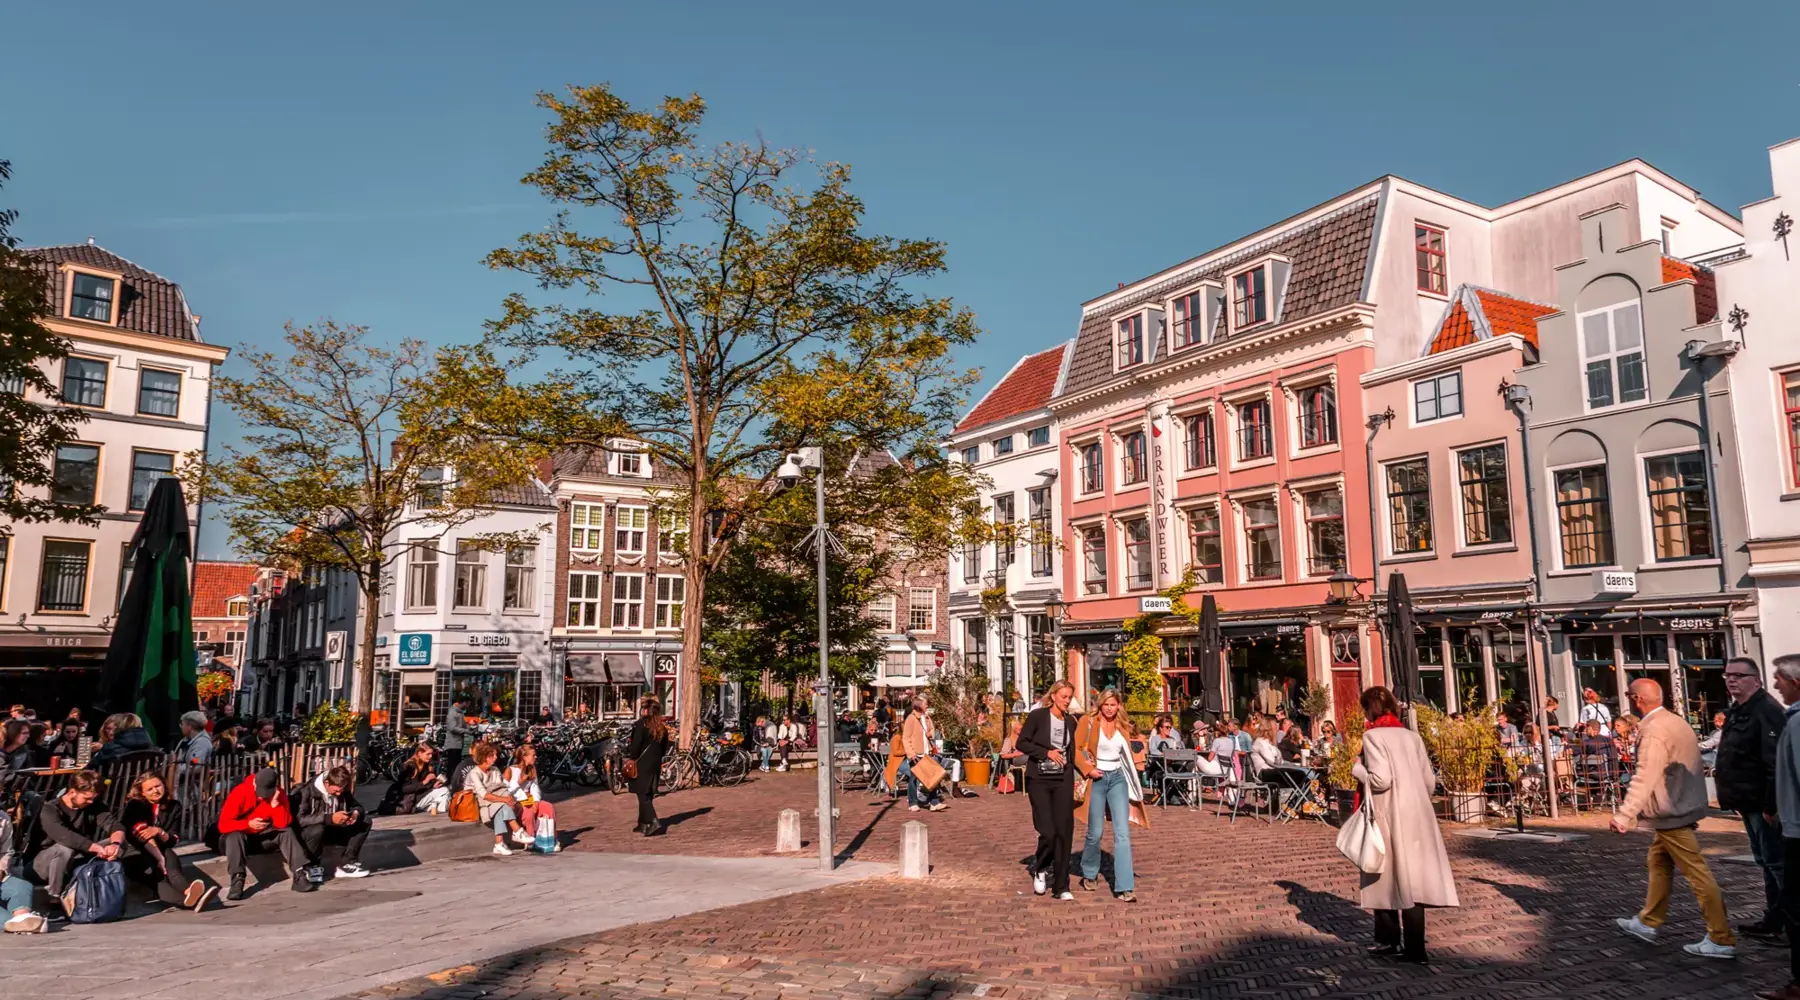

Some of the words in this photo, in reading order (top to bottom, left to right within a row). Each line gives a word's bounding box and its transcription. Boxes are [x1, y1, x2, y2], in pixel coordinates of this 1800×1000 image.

[1154, 445, 1169, 575] BRANDWEER
[1606, 574, 1634, 586] daen's
[1144, 600, 1171, 608] daen's
[46, 638, 82, 646] UBICA
[468, 634, 480, 646] EL
[482, 635, 510, 647] GRECO
[402, 650, 408, 658] EL
[657, 659, 673, 672] 30
